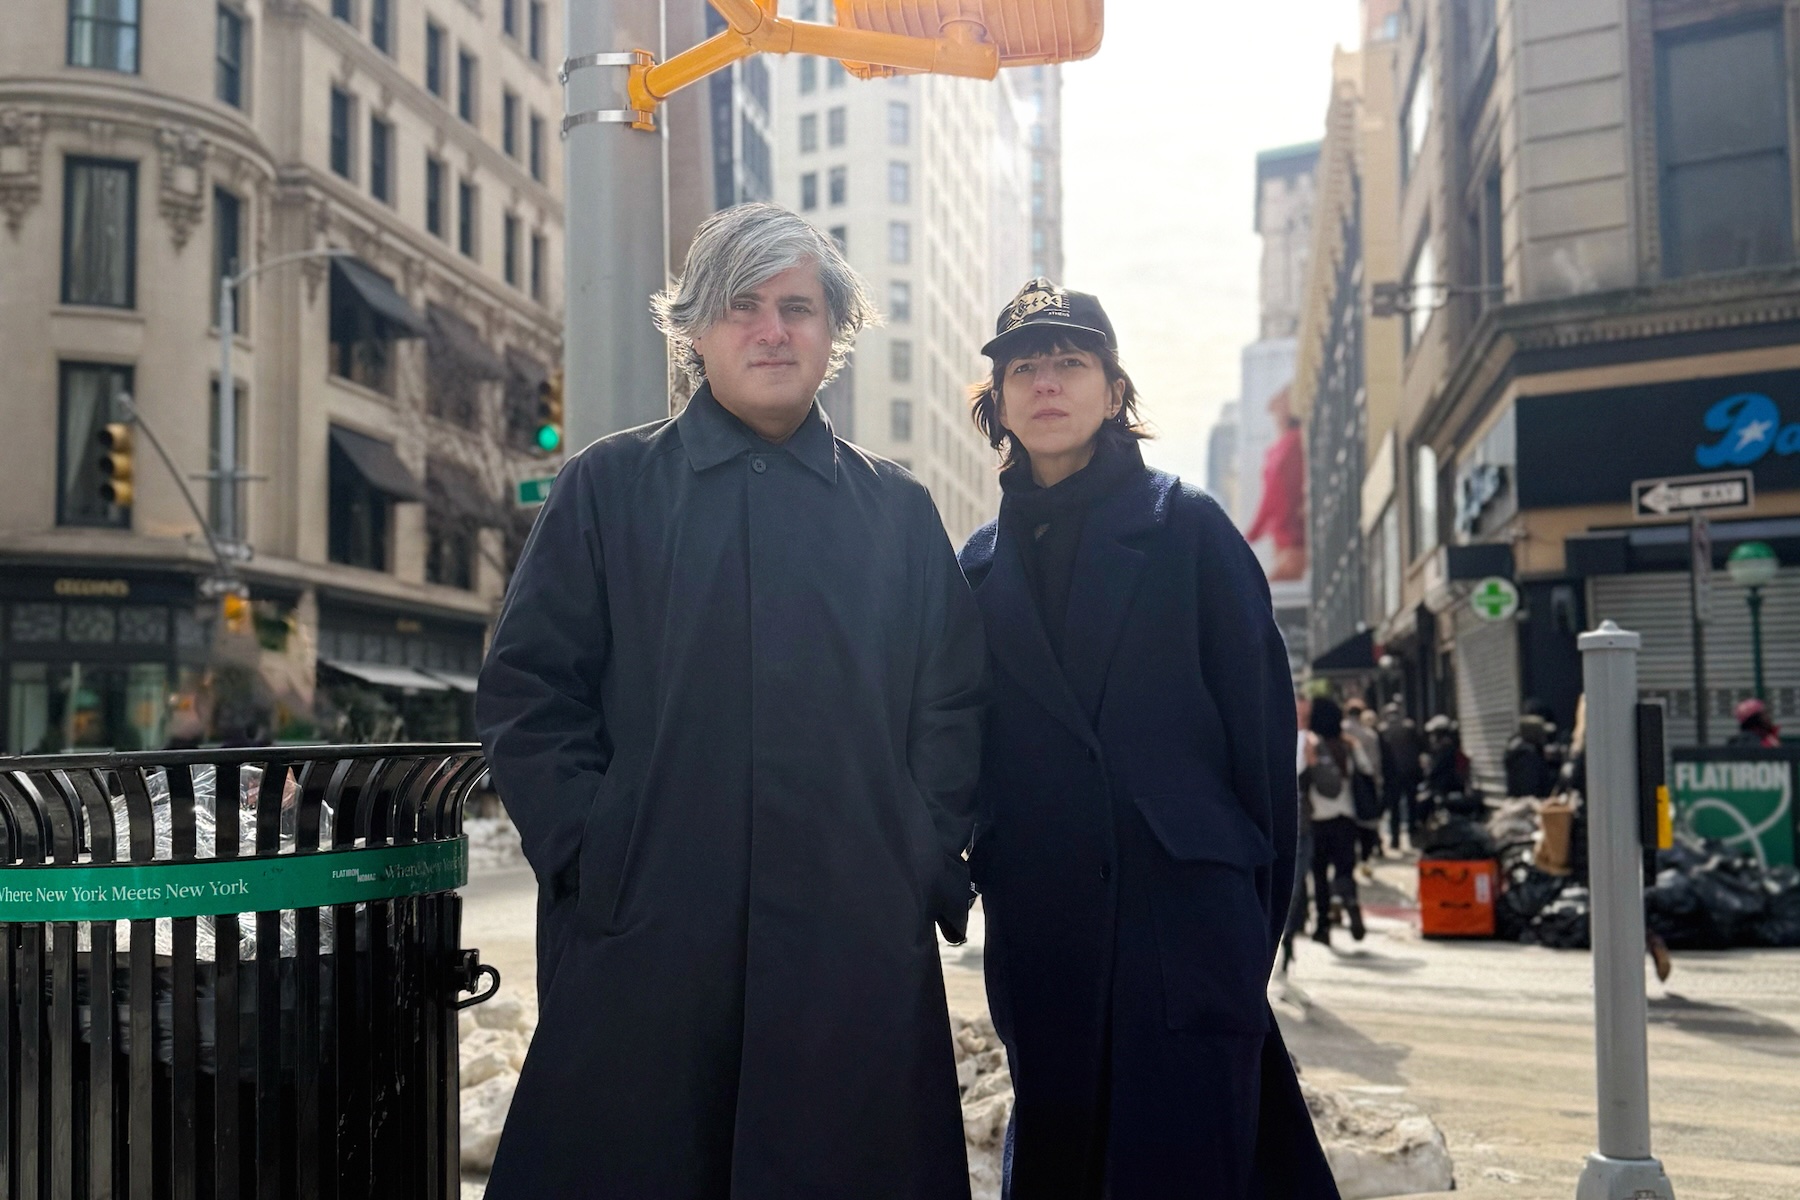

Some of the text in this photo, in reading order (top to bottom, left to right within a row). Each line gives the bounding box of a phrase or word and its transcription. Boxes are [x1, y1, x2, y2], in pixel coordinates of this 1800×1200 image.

[1701, 486, 1735, 500] WAY
[1675, 761, 1791, 791] FLATIRON
[332, 868, 359, 879] FLATIRON
[36, 887, 68, 902] New
[72, 885, 107, 902] York
[112, 885, 161, 902] Meets
[165, 883, 205, 899] New
[209, 878, 249, 896] York
